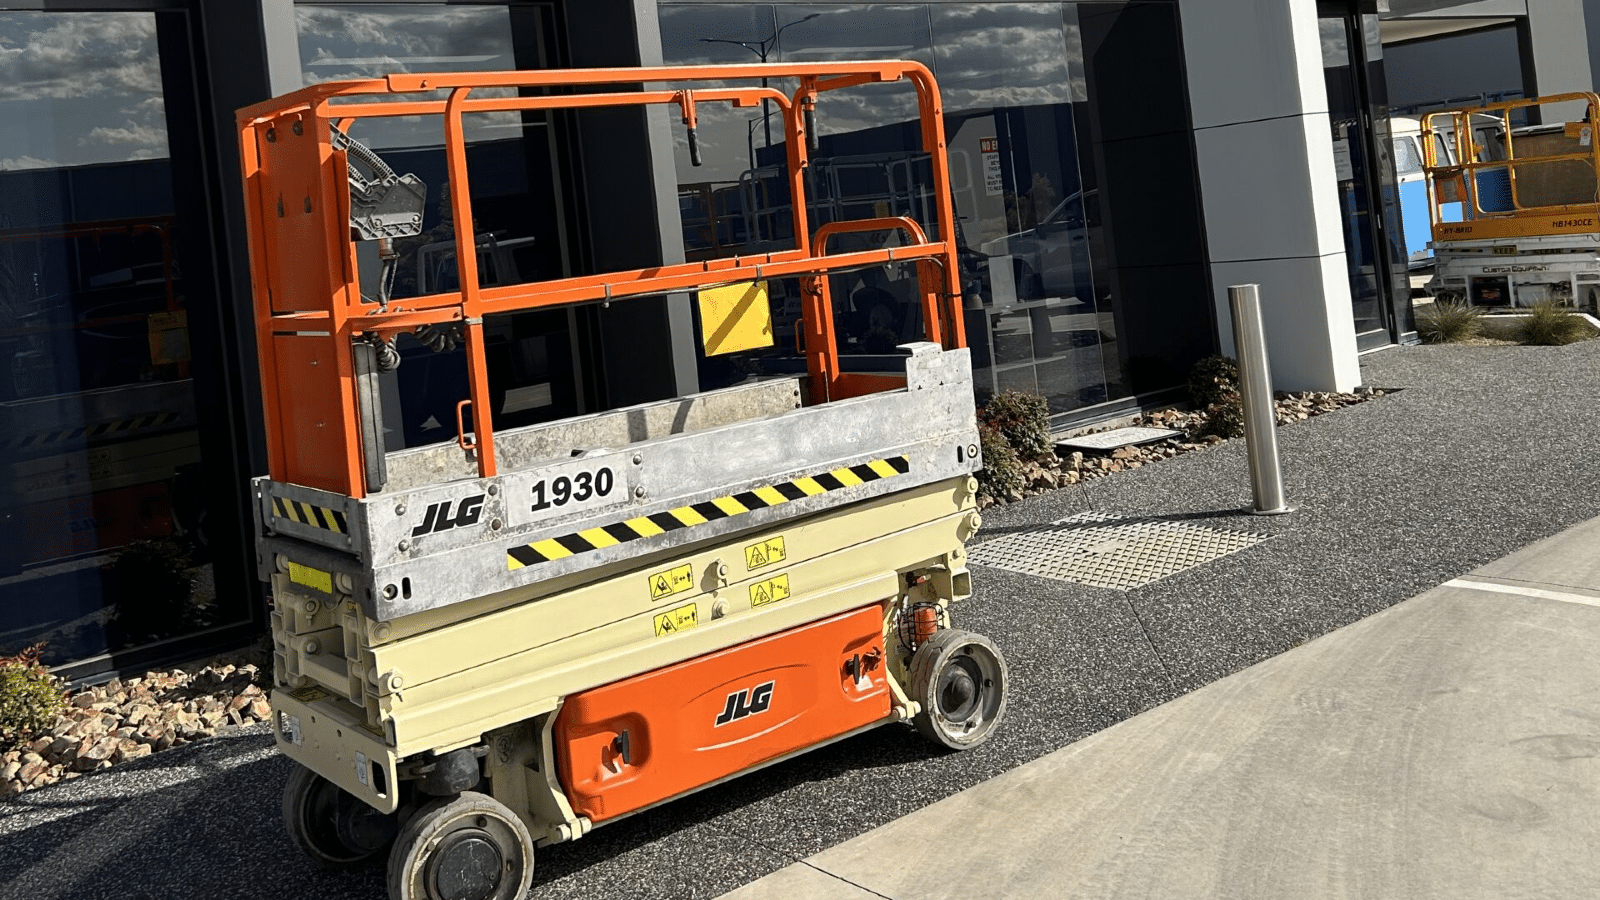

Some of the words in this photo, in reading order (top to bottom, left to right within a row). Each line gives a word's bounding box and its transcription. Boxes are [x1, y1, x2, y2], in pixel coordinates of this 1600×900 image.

[981, 141, 991, 152] NO
[1552, 218, 1593, 229] HB1430CE
[531, 467, 614, 512] 1930
[411, 493, 486, 538] JLG
[715, 681, 775, 727] JLG
